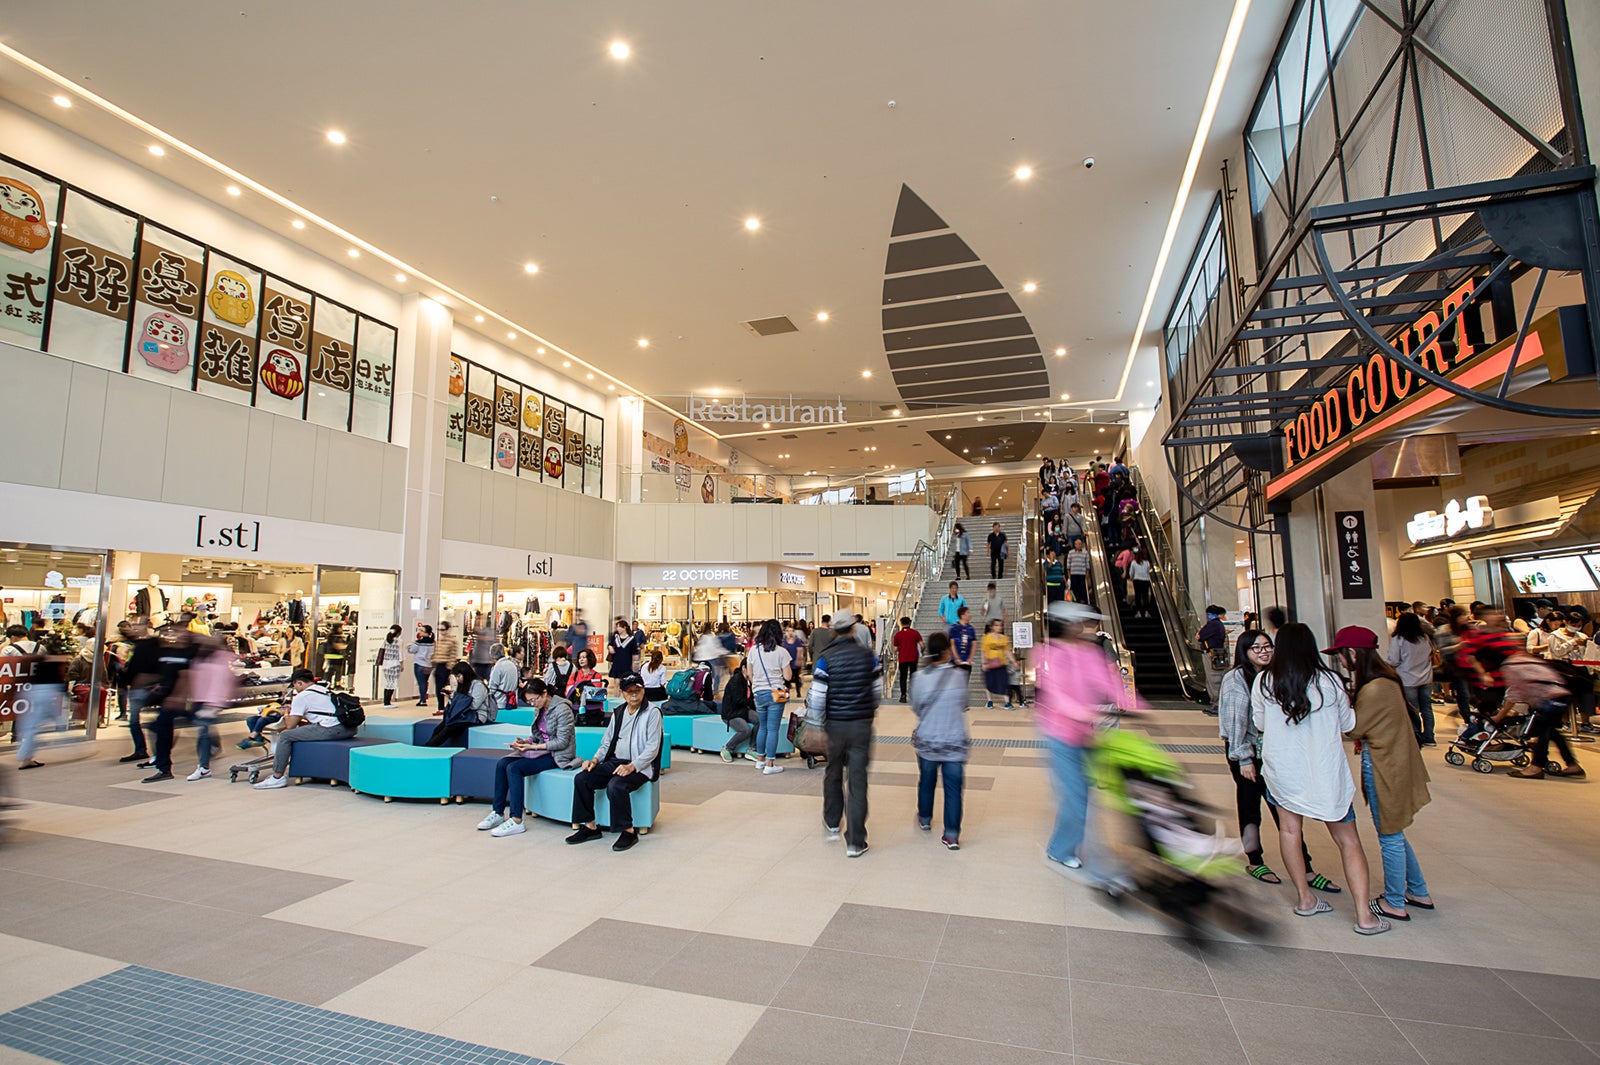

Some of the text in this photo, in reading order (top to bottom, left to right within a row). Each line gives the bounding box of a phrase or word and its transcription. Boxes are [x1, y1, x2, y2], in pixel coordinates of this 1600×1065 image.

[0, 302, 43, 325] 紅茶
[356, 358, 392, 386] 日式
[1284, 277, 1476, 469] FOOD COURT
[689, 396, 847, 424] Restaurant
[662, 569, 739, 581] 22 OCTOBRE
[15, 682, 33, 692] TO
